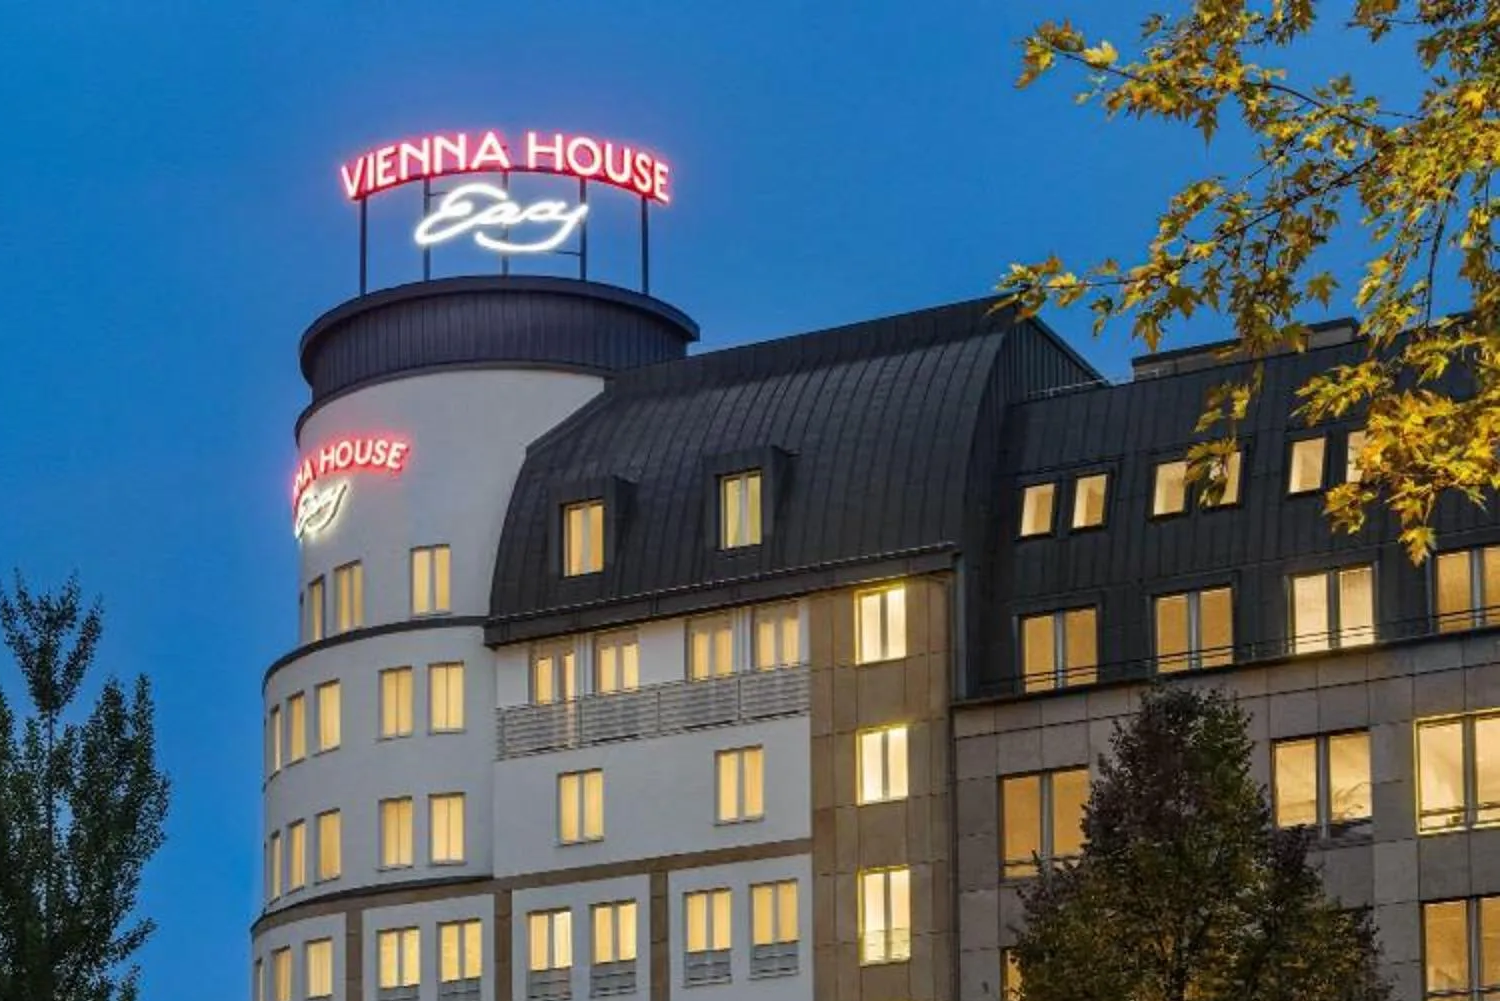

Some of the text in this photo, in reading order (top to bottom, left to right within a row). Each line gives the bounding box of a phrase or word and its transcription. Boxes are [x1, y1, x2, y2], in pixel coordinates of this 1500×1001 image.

[341, 131, 670, 203] VIENNA HOUSE
[413, 183, 589, 252] Easy
[319, 439, 407, 472] HOUSE
